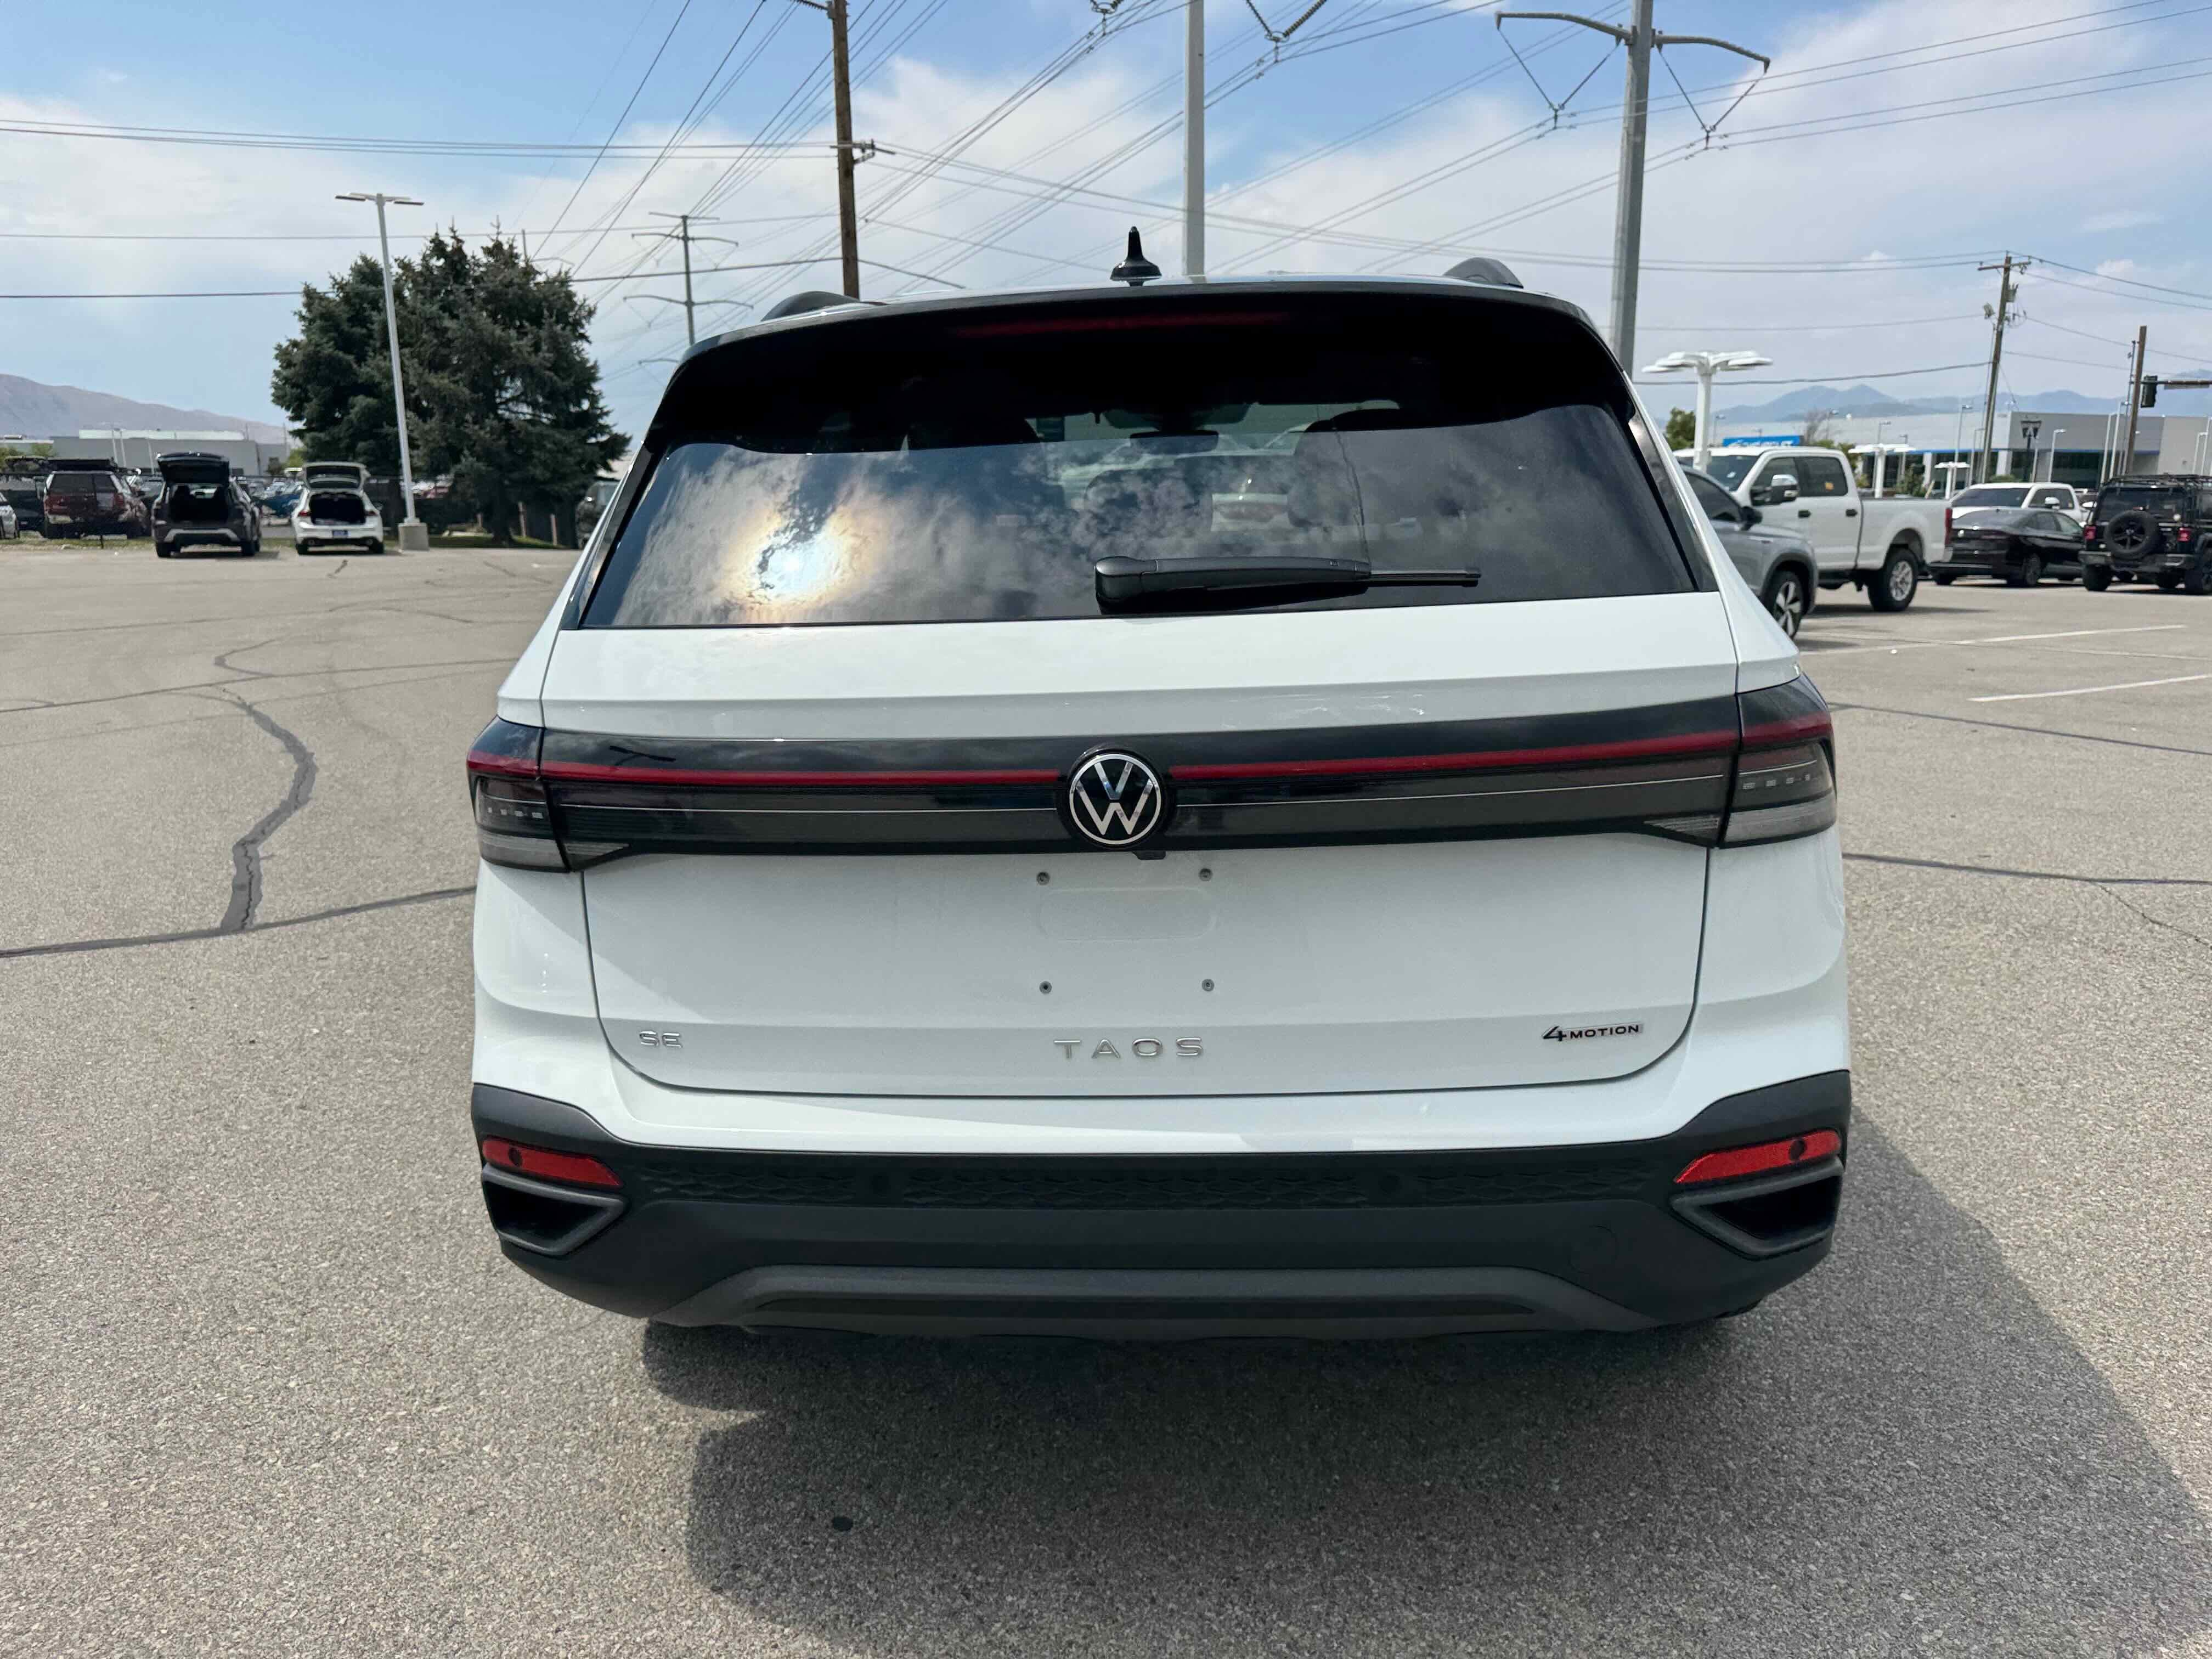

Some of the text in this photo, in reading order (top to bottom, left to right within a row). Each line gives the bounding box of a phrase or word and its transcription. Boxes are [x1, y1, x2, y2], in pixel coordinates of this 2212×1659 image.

[1075, 758, 1154, 837] VW
[639, 1031, 682, 1047] SE
[1542, 1025, 1640, 1042] 4MOTION
[1053, 1037, 1203, 1059] TAOS
